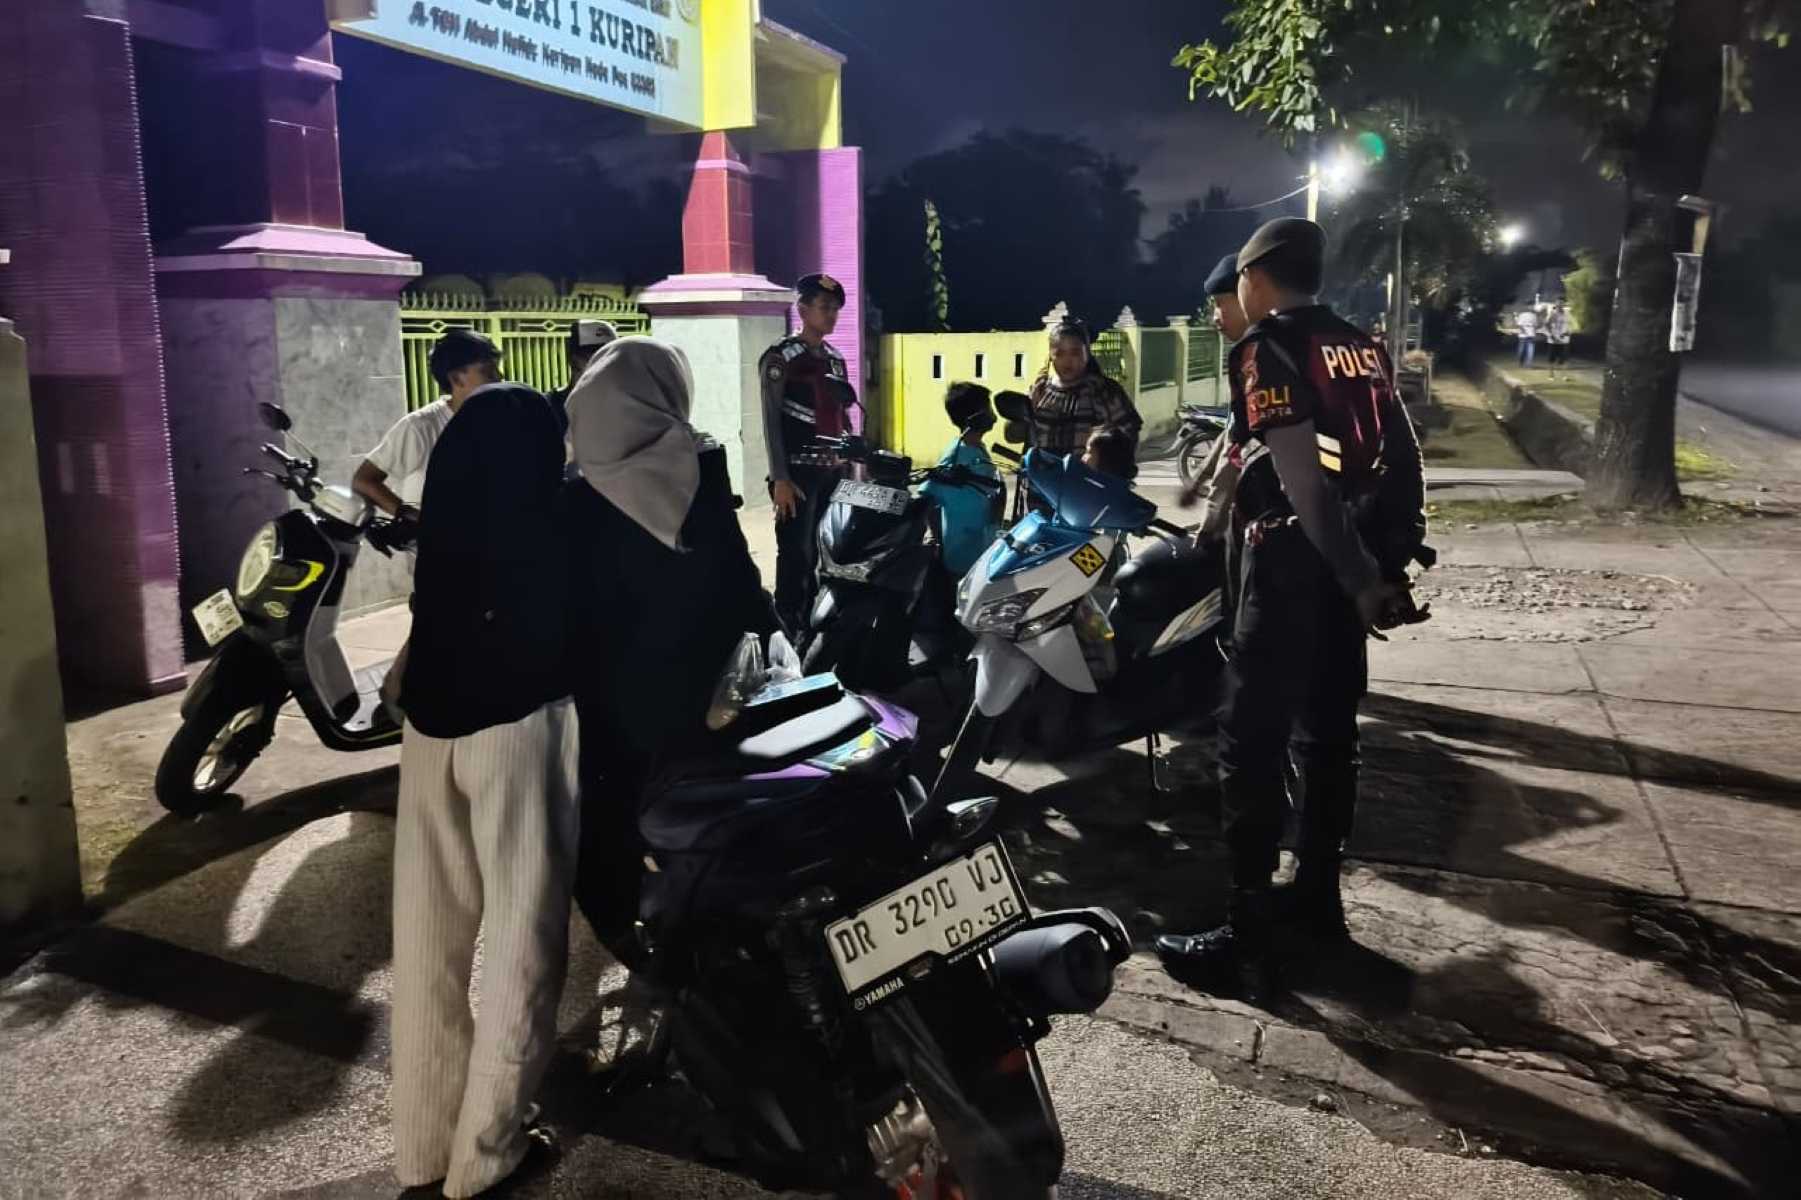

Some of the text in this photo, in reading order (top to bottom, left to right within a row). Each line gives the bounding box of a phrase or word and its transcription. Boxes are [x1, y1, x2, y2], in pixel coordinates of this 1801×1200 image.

[588, 6, 679, 71] KURIPAN
[834, 853, 1002, 964] DR 3290 VJ
[864, 976, 905, 1006] YAMAHA
